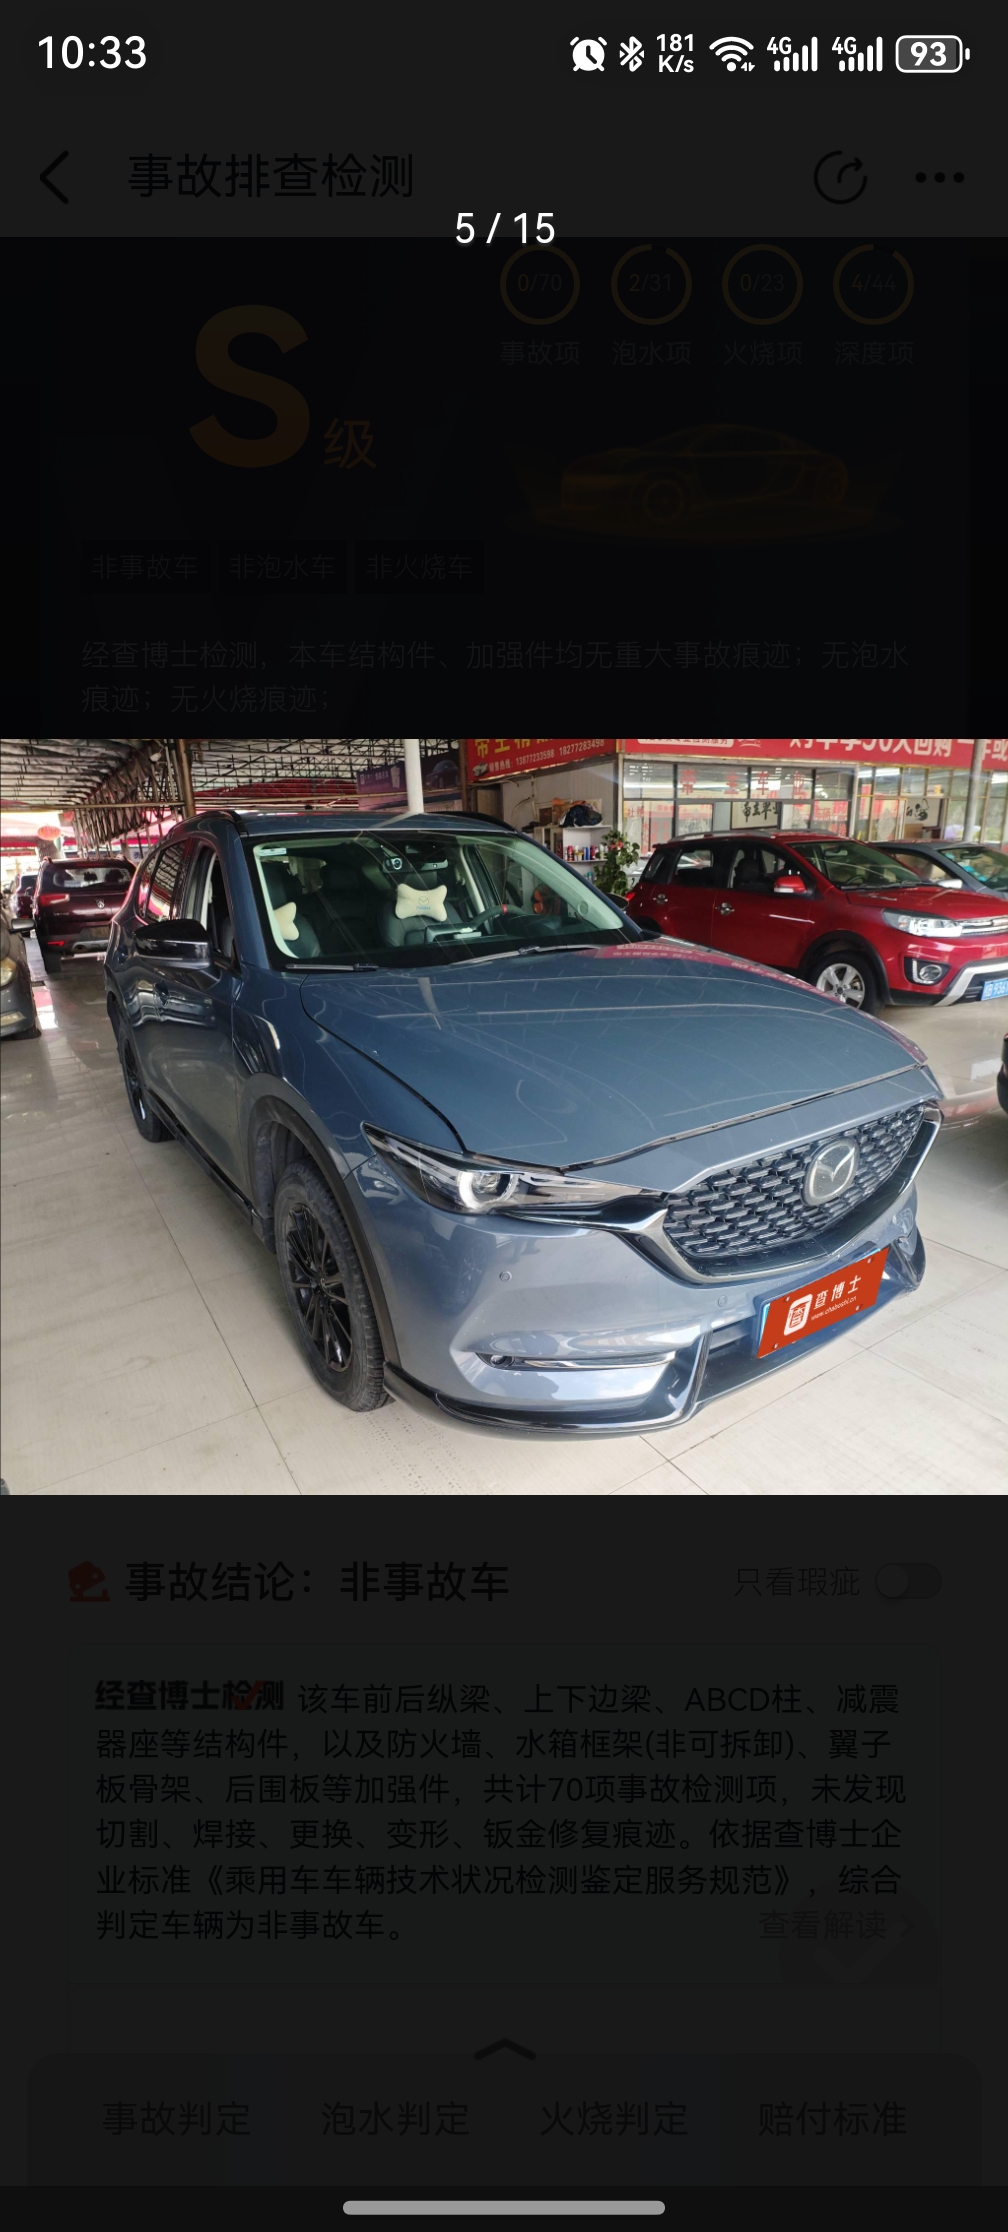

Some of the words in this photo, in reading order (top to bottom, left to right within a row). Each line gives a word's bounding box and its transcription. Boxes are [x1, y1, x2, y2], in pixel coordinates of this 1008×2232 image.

[39, 36, 146, 69] 10:33
[657, 34, 693, 51] 181
[767, 37, 791, 54] 4G
[832, 37, 856, 54] 4G
[911, 42, 946, 66] 93
[659, 55, 694, 72] K/s
[128, 153, 412, 197] 事故排查检测
[456, 213, 474, 243] 5
[514, 213, 554, 243] 15
[518, 274, 561, 291] 0/70
[629, 274, 670, 292] 2/31
[740, 274, 784, 291] 0/23
[852, 274, 896, 291] 4/44
[500, 340, 580, 365] 事故项
[612, 340, 691, 365] 泡水项
[724, 340, 802, 365] 火烧项
[835, 341, 913, 365] 深度项
[189, 304, 310, 468] S
[324, 418, 376, 469] 级
[92, 554, 197, 579] 非事故车
[230, 554, 335, 579] 非泡水车
[367, 554, 472, 579] 非火烧车
[813, 1275, 861, 1310] 查博士
[126, 1561, 508, 1601] 事故结论：非事故车
[735, 1566, 859, 1596] 只看瑕疵
[95, 1680, 284, 1710] 经查博士检测
[759, 1911, 886, 1940] 查看解读
[103, 2100, 251, 2136] 事故判定
[322, 2101, 469, 2136] 泡水判定
[541, 2101, 688, 2136] 火烧判定
[759, 2101, 906, 2136] 赔付标准
